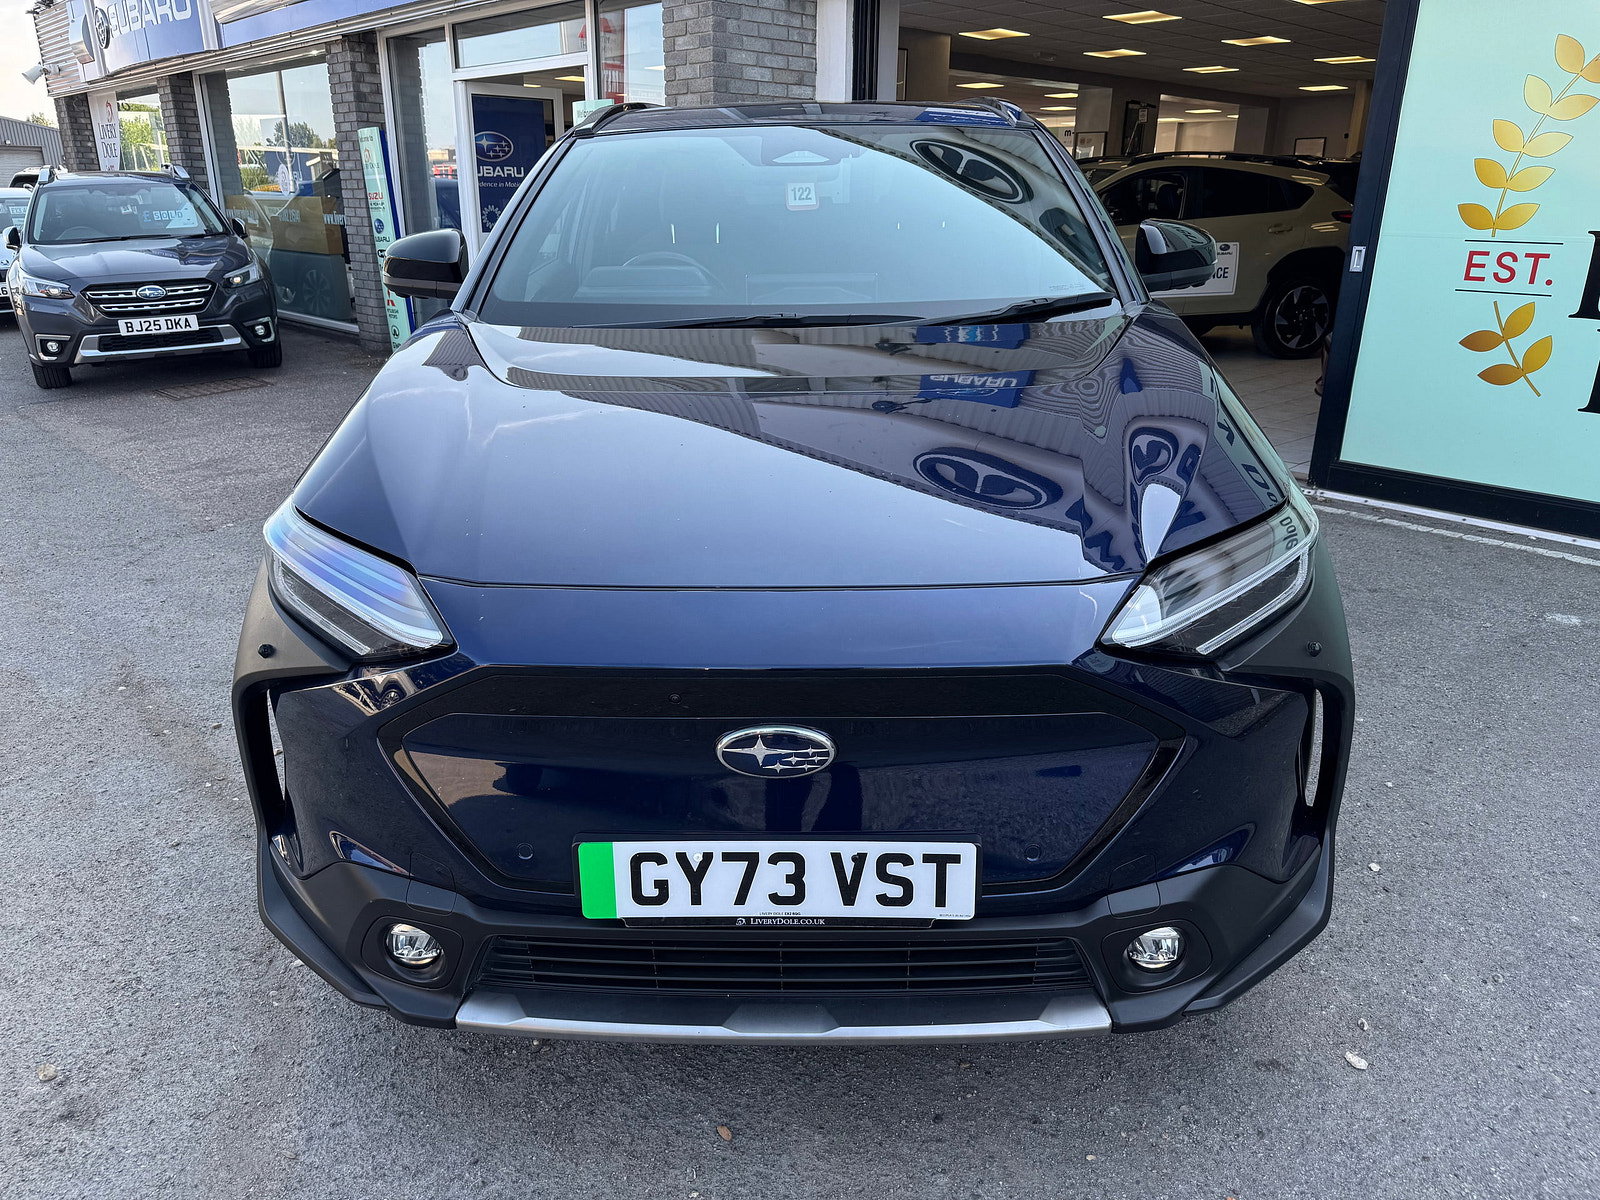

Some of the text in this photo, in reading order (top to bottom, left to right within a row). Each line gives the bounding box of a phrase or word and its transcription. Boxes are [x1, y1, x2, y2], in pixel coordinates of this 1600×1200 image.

[477, 165, 525, 178] UBARU
[791, 186, 813, 201] 122
[1463, 250, 1554, 287] EST.
[124, 317, 193, 333] BJ25 DKA
[629, 851, 962, 909] GY73 VST
